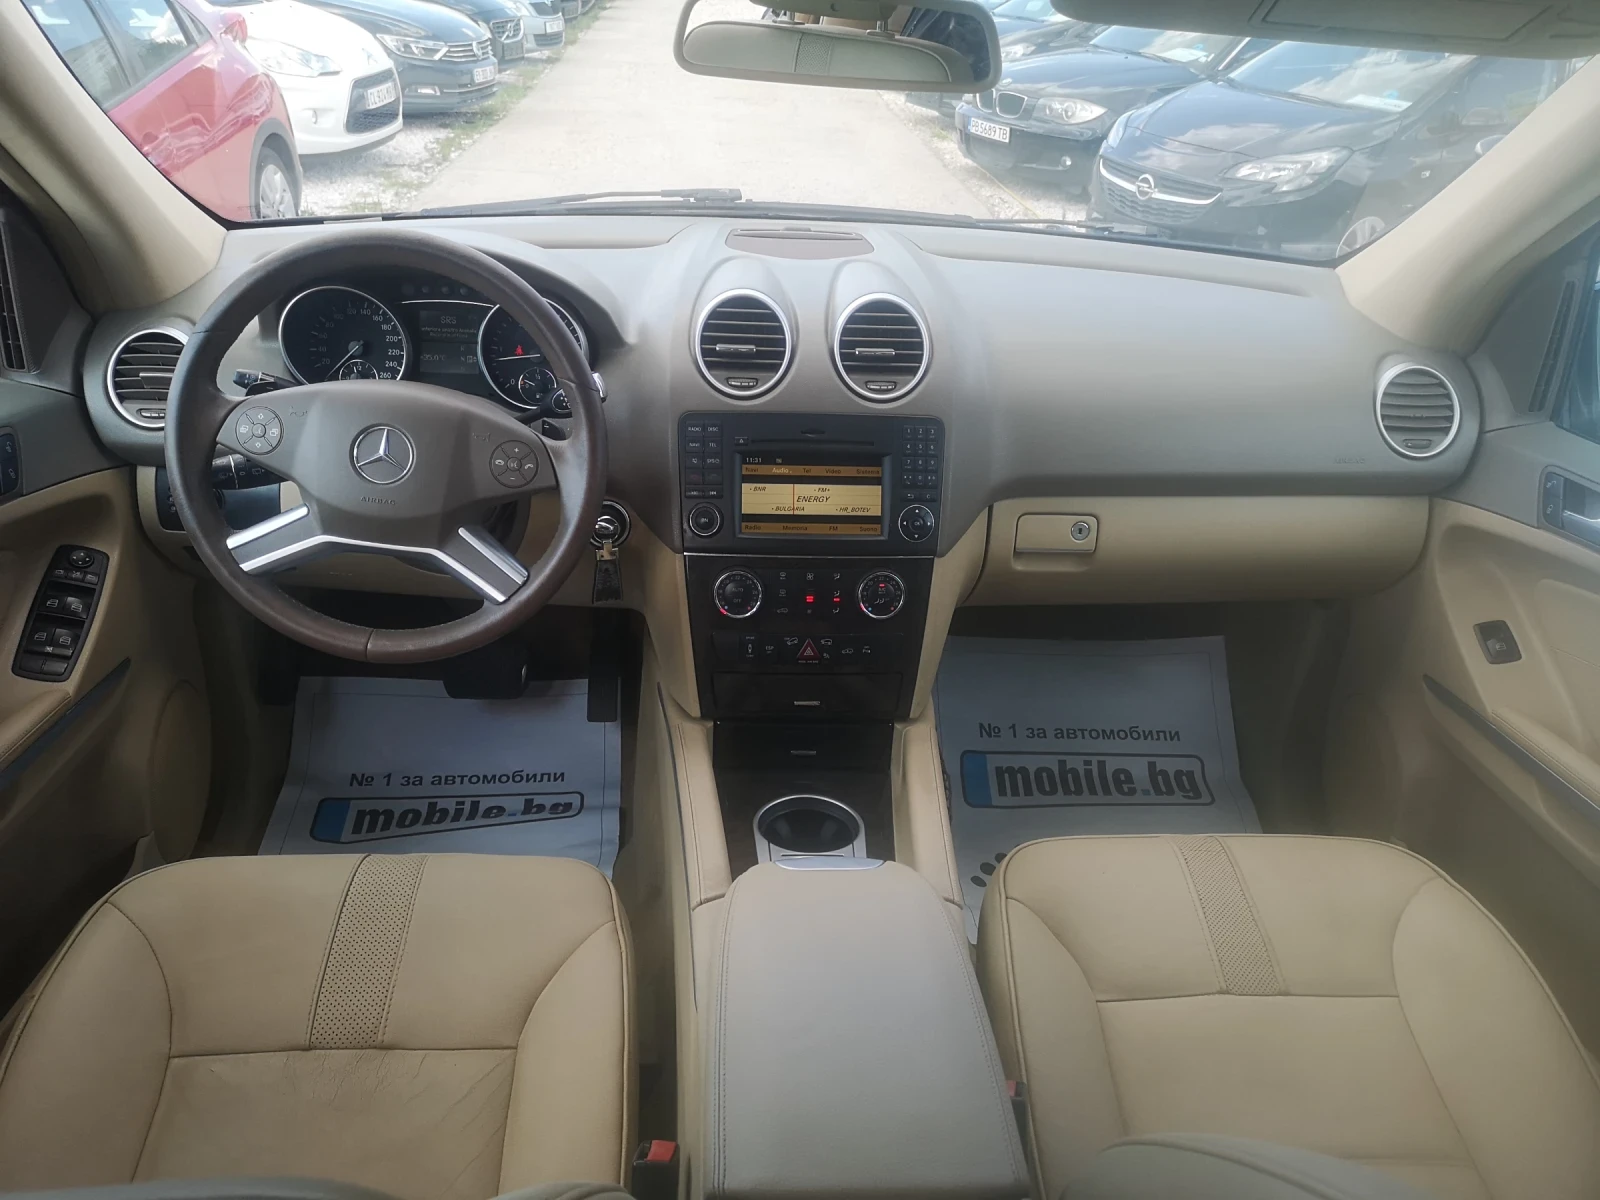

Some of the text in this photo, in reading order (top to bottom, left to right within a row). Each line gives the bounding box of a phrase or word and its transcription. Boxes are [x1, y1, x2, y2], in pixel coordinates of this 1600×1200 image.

[440, 316, 456, 324] SRS
[360, 496, 396, 506] AIRBAG
[1008, 723, 1018, 739] 1
[1025, 726, 1048, 740] за
[1054, 725, 1182, 742] автомобили
[382, 772, 392, 786] 1
[400, 774, 424, 787] за
[430, 769, 566, 787] автомобили
[994, 759, 1203, 800] mobile.bg
[350, 798, 574, 835] mobile.bg
